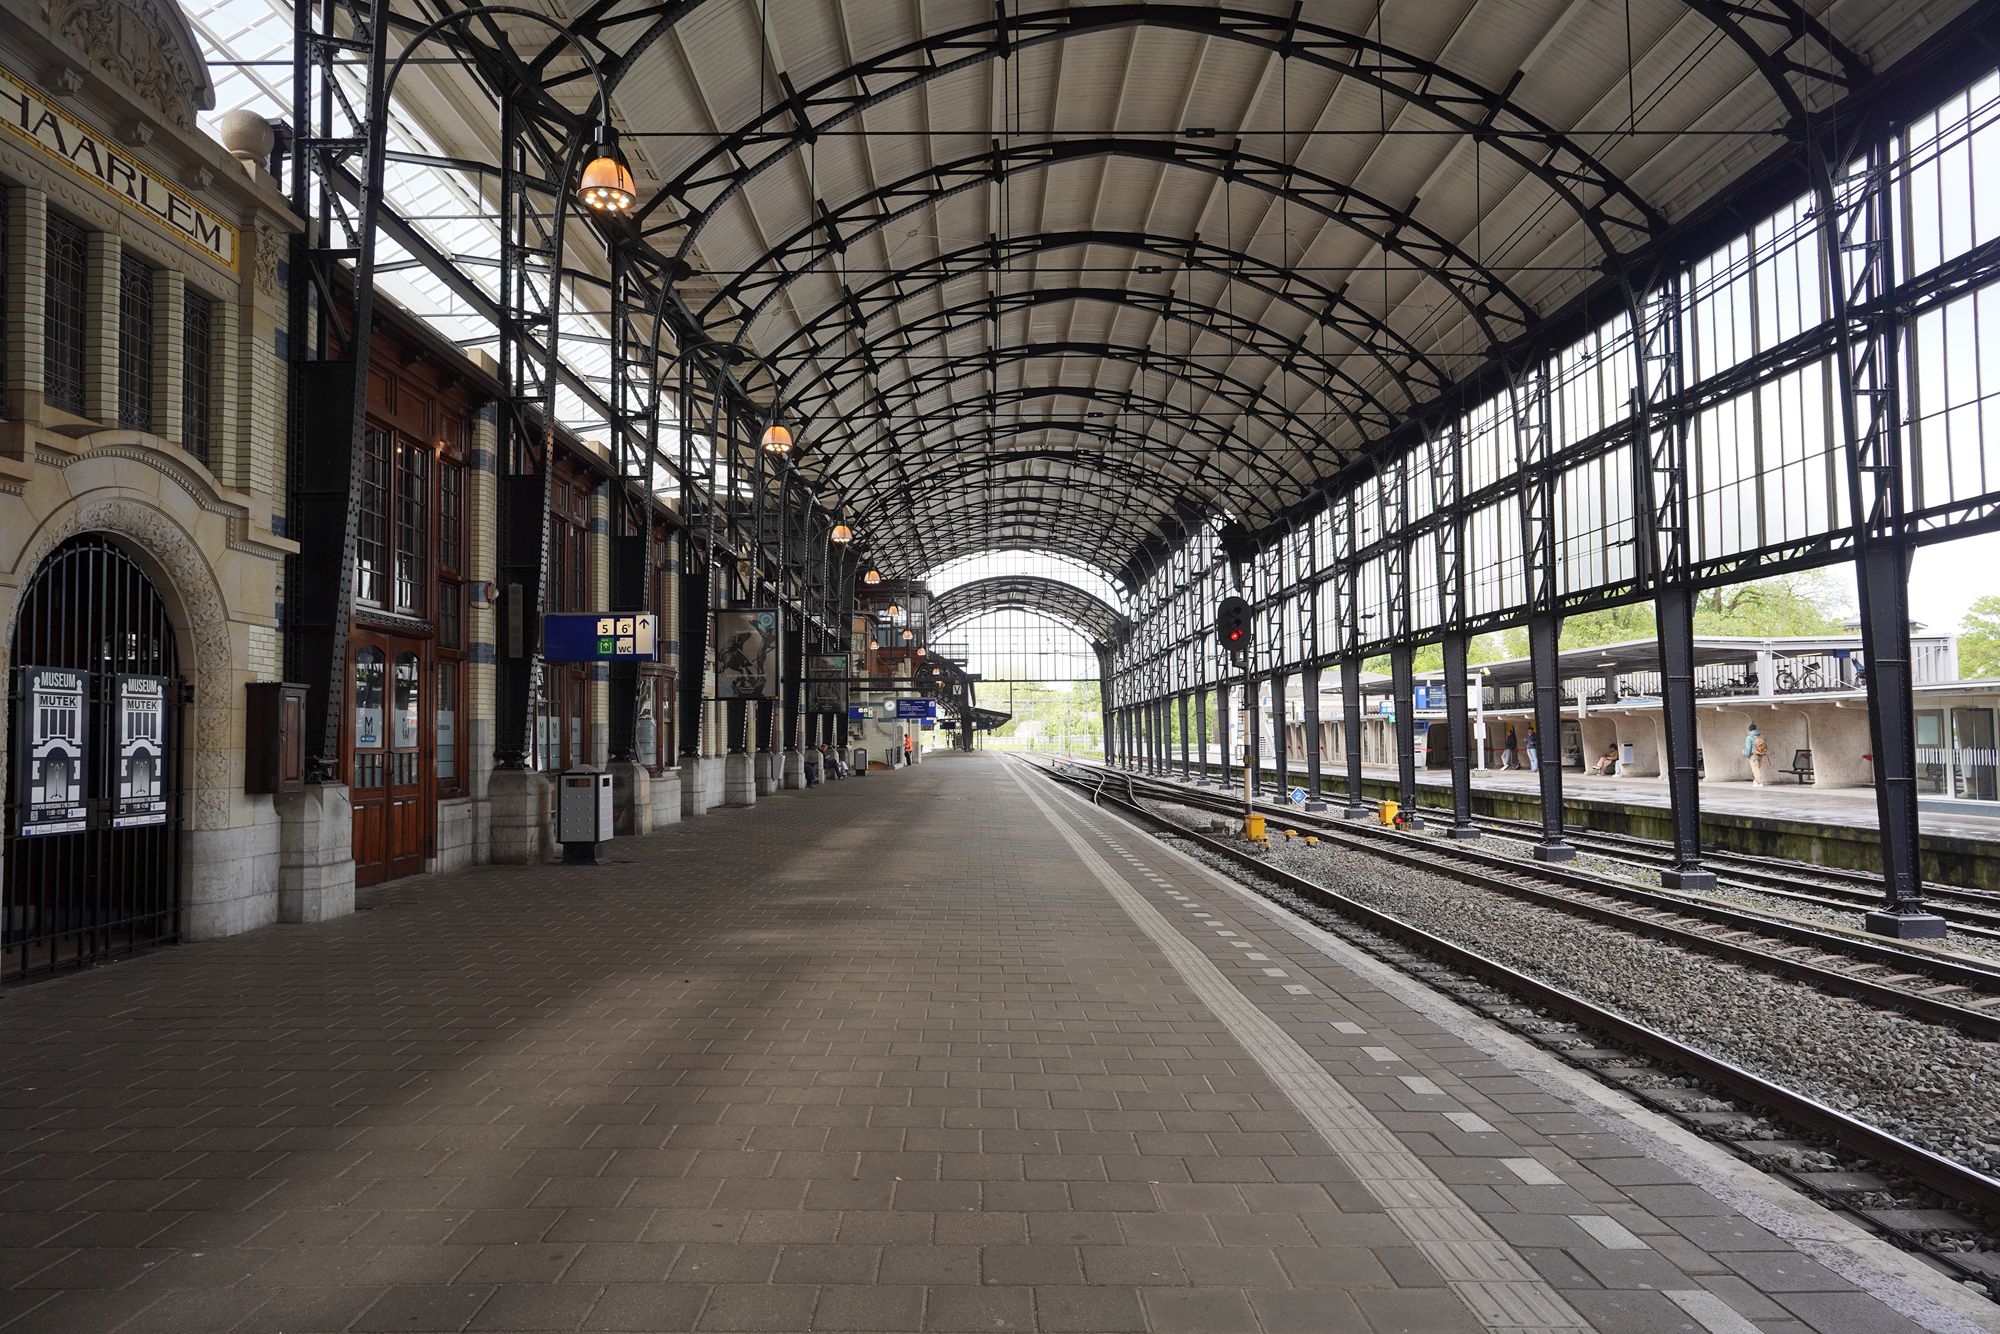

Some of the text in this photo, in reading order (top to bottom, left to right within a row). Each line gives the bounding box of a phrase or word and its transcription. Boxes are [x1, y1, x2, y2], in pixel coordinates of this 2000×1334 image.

[0, 90, 221, 253] HAARLEM
[602, 624, 608, 633] 5
[41, 672, 76, 688] MUSEUM
[127, 678, 157, 692] MUSEUM
[40, 695, 76, 706] MUTEK
[127, 700, 157, 710] MUTEK
[1294, 792, 1302, 800] 2
